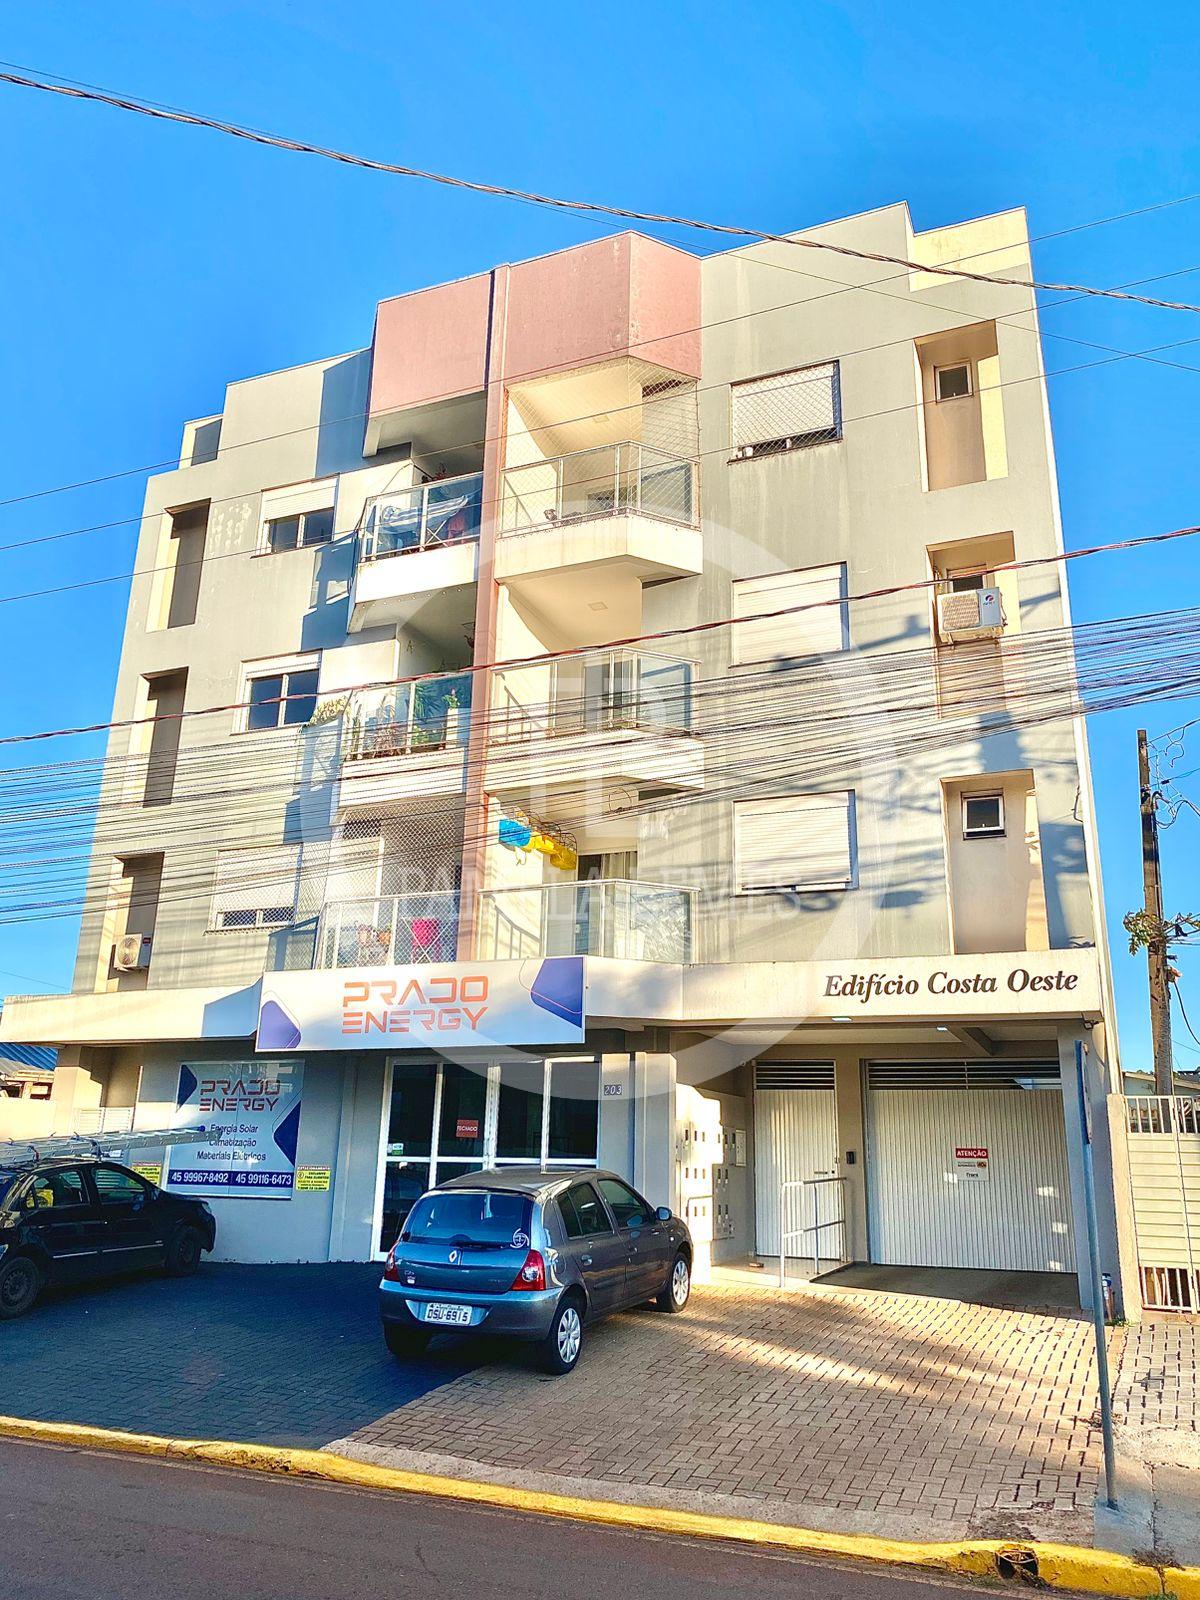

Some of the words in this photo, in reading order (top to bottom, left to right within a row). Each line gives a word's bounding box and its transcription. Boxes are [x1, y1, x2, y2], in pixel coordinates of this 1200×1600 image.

[343, 976, 488, 1007] PRADO
[823, 973, 919, 1004] Edifício
[928, 971, 998, 995] Costa
[1007, 968, 1079, 992] Oeste
[342, 1007, 488, 1034] ENERGY
[200, 1079, 280, 1096] PRADO
[604, 1085, 622, 1095] 203
[199, 1098, 279, 1112] ENERGY
[210, 1123, 237, 1135] Energia
[239, 1123, 258, 1133] Solar
[209, 1137, 257, 1148] Climatização
[197, 1150, 231, 1160] Materiais
[232, 1151, 266, 1161] Elétricos
[956, 1149, 987, 1158] ATENÇÃO
[171, 1172, 181, 1182] 45
[183, 1172, 229, 1183] 99967-8492
[235, 1173, 246, 1184] 45
[248, 1174, 292, 1185] 99116-6473
